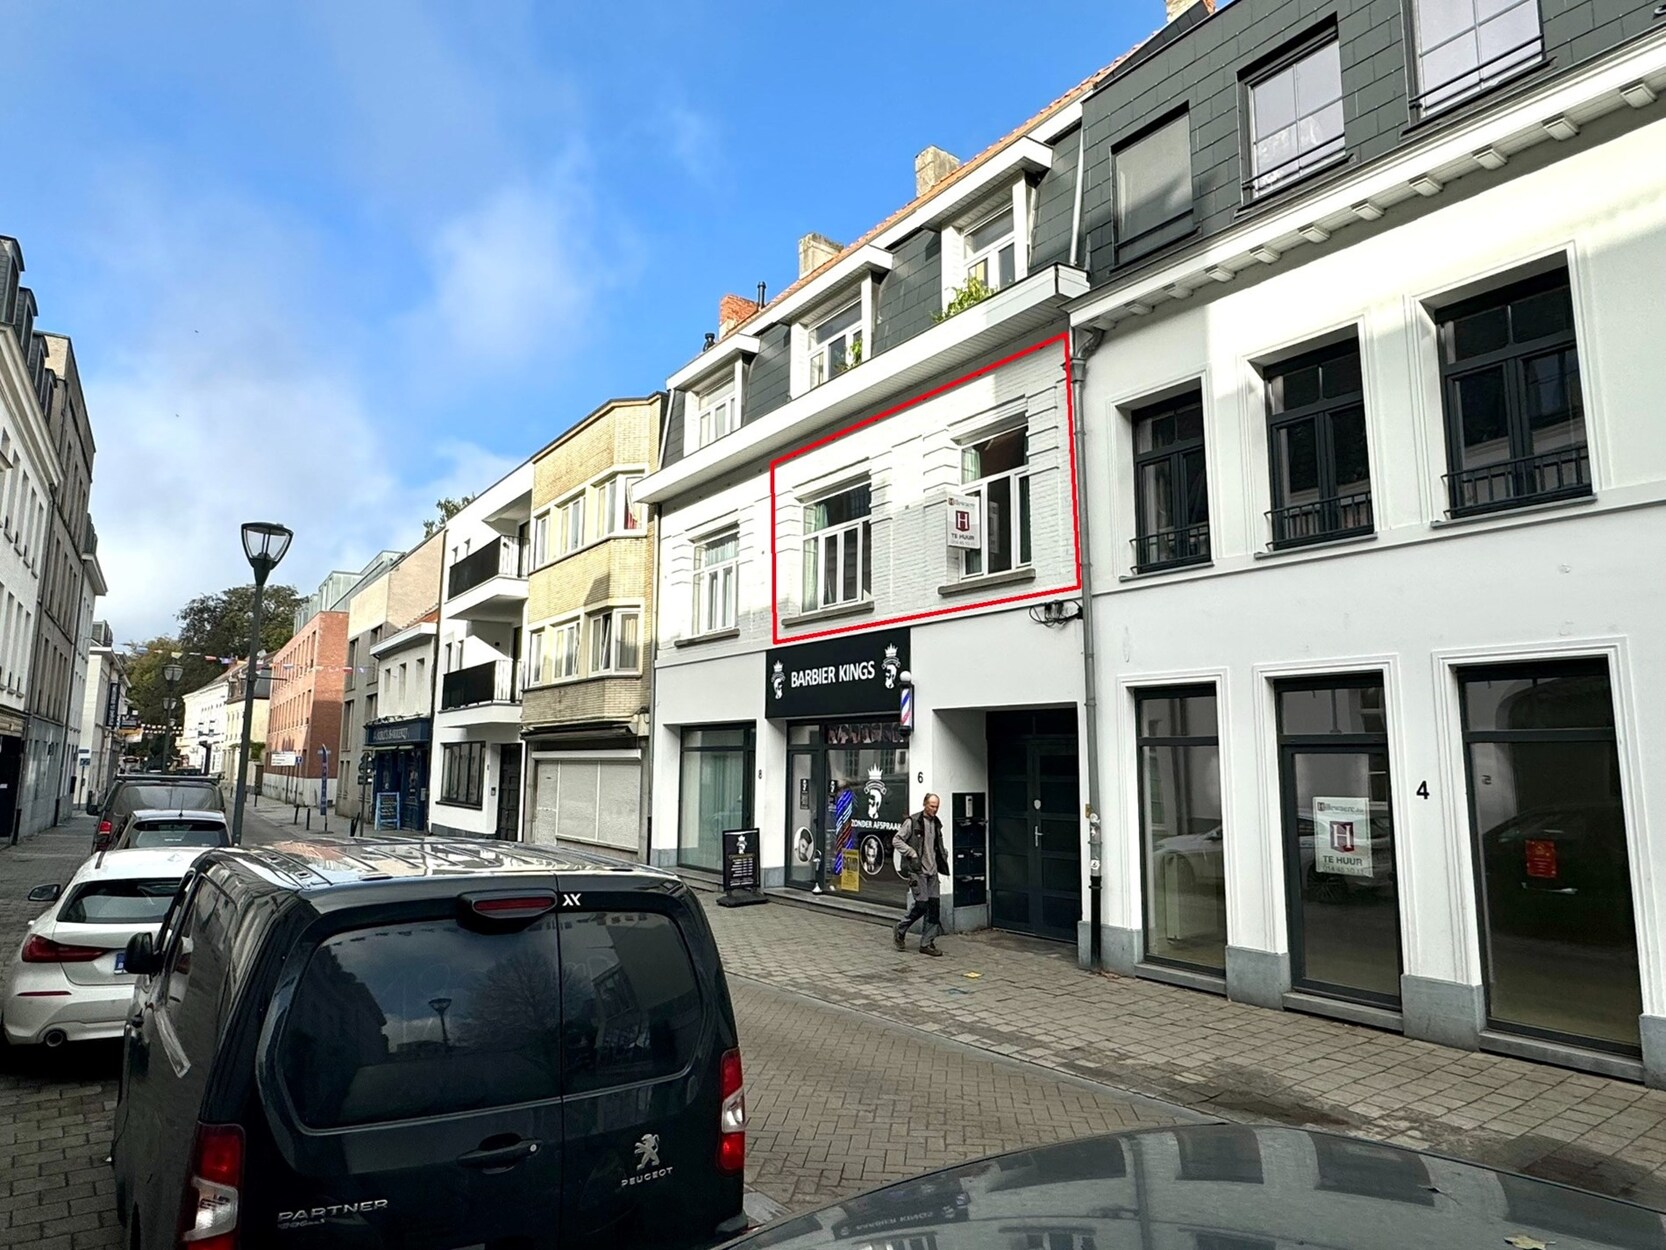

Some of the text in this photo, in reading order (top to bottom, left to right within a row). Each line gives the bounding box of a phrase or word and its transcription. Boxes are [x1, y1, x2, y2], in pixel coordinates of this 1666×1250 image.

[957, 512, 968, 529] H
[791, 661, 875, 688] BARBIER KINGS
[917, 771, 924, 784] 6
[1416, 780, 1430, 800] 4
[851, 819, 872, 828] ZONDER
[1333, 824, 1351, 849] H
[1323, 855, 1363, 866] TE HUUR
[621, 1166, 673, 1187] PEUGEOT
[278, 1199, 388, 1221] PARTNER
